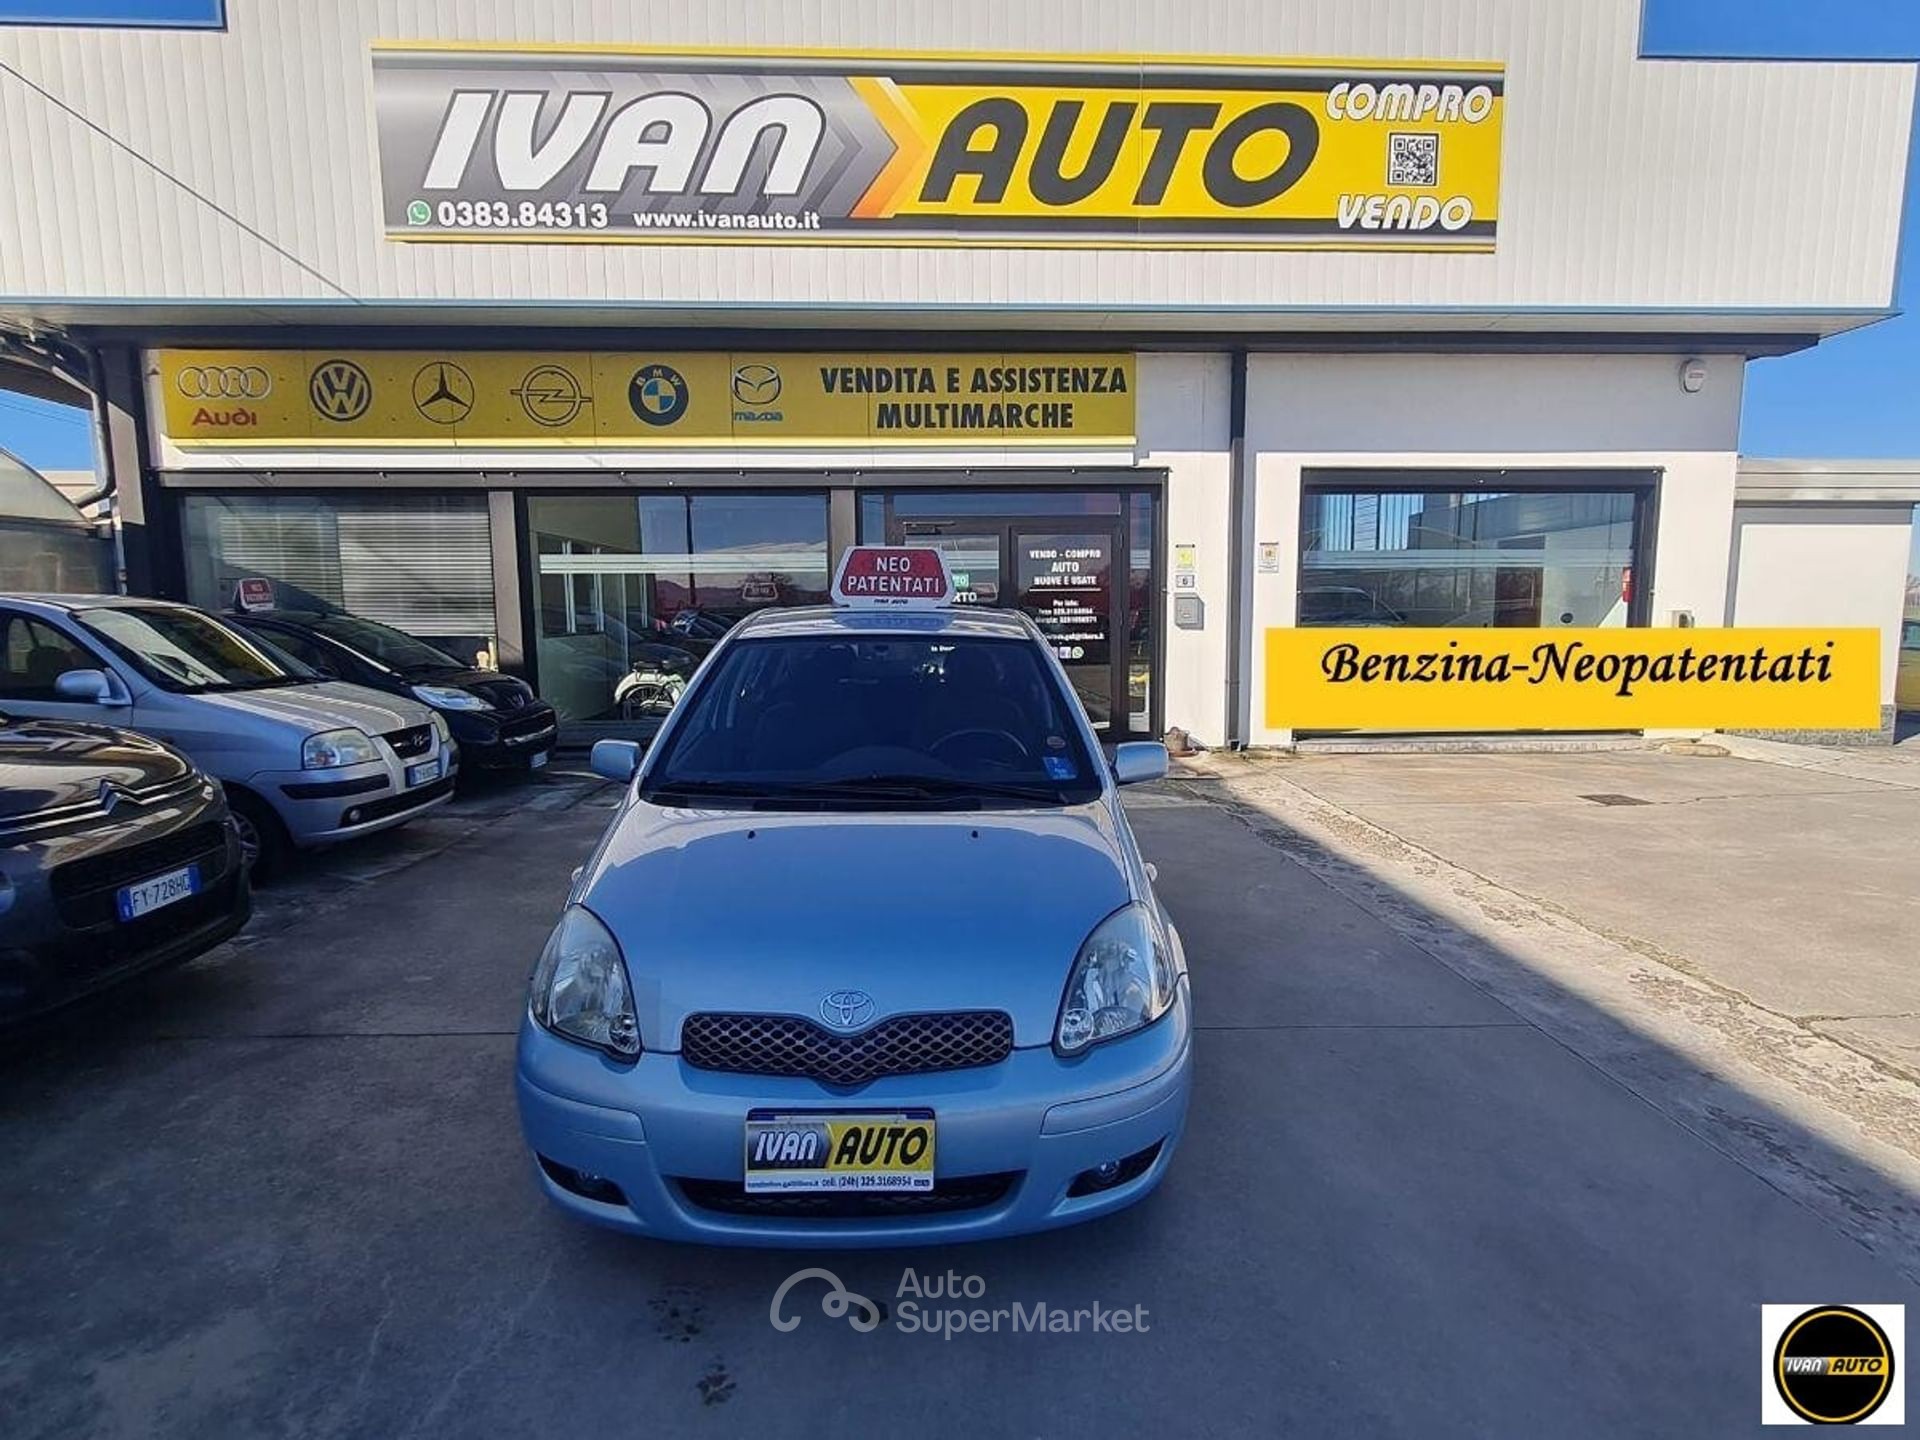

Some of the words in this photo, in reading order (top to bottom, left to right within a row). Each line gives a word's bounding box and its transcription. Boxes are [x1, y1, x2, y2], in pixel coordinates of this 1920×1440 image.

[1325, 82, 1494, 124] COMPRO
[423, 89, 826, 195] IVAN
[918, 97, 1320, 207] AUTO
[437, 200, 608, 229] 0383.84313
[633, 210, 821, 230] www.ivanauto.it
[1337, 194, 1473, 231] VENDO
[820, 367, 933, 393] VENDITA
[948, 367, 960, 393] E
[971, 366, 1128, 393] ASSISTENZA
[191, 408, 258, 426] Audi
[876, 403, 1075, 429] MULTIMARCHE
[876, 556, 911, 572] NEO
[1029, 549, 1058, 559] VENDO
[1051, 561, 1080, 573] AUTO
[847, 575, 941, 593] PATENTATI
[755, 1130, 818, 1162] IVAN
[833, 1126, 929, 1166] AUTO
